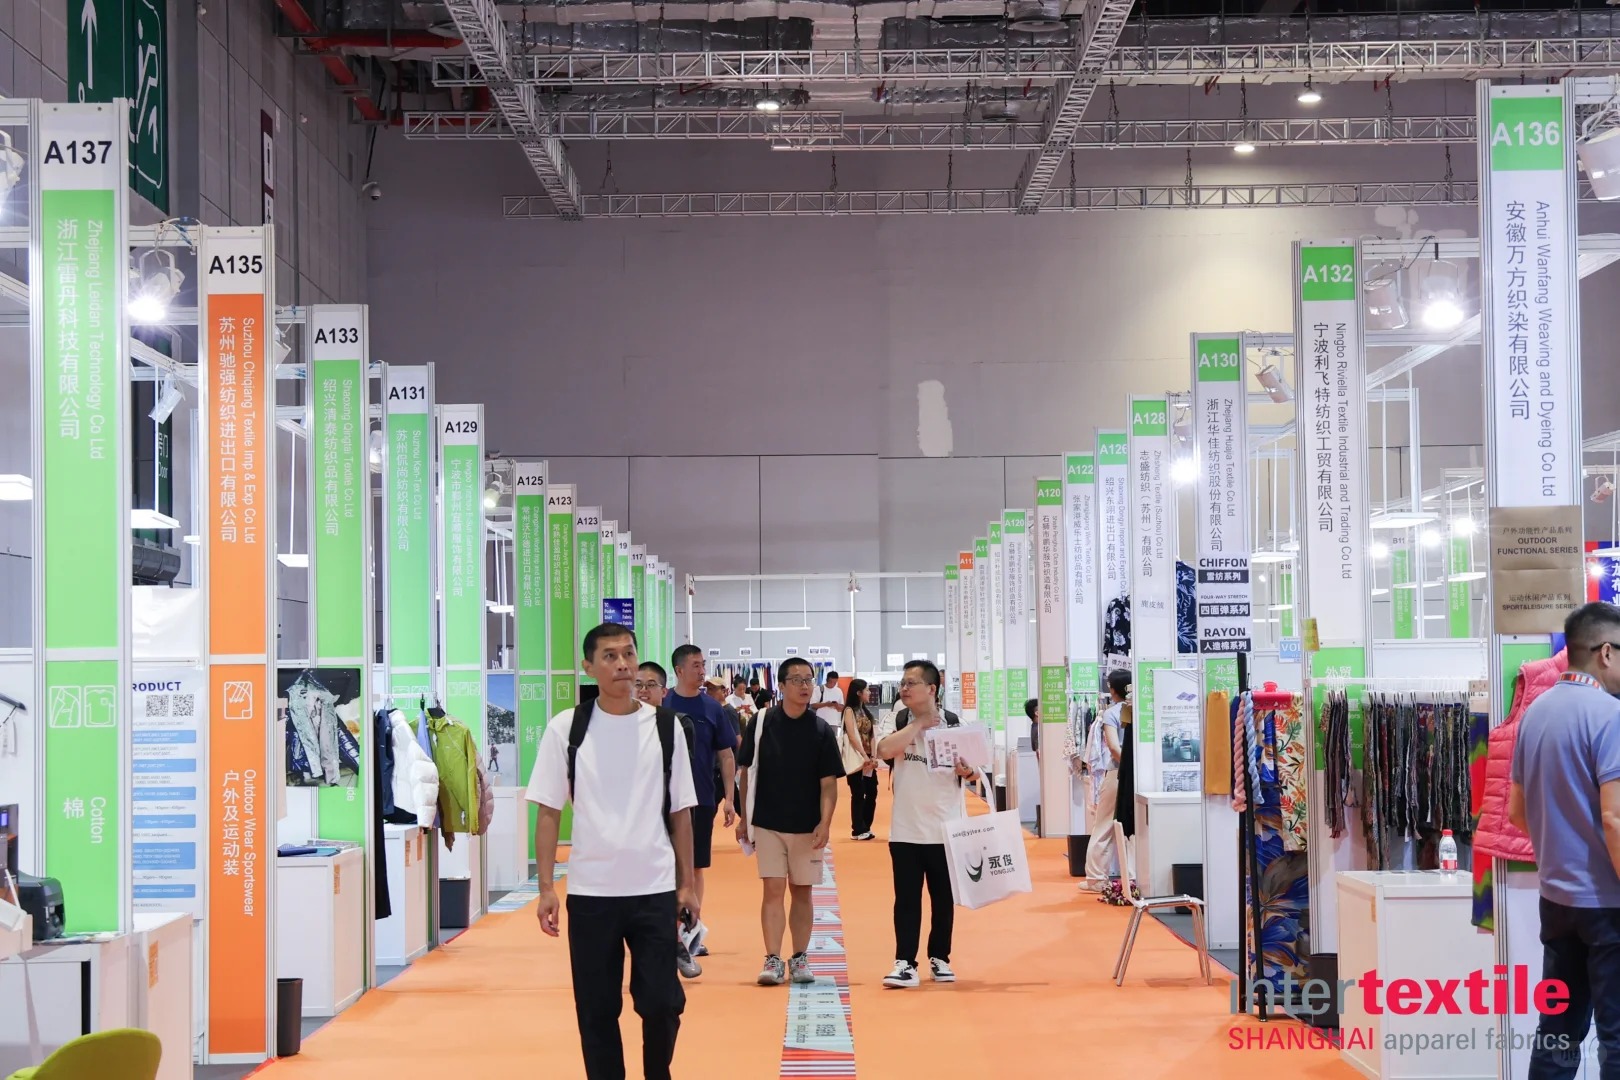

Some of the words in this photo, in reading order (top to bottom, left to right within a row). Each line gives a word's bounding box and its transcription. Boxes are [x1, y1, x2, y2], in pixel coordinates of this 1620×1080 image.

[1491, 121, 1560, 146] A136
[44, 140, 113, 164] A137
[1537, 200, 1550, 239] Anhui
[85, 219, 103, 278] Zhejiang
[209, 255, 263, 275] A135
[1303, 264, 1354, 283] A132
[1534, 244, 1552, 304] Wanfang
[88, 282, 103, 328] Leidan
[1505, 200, 1530, 420] 安徽万方织染有限公司
[56, 218, 80, 441] 浙江雷丹科技有限公司
[243, 317, 254, 358] Suzhou
[314, 328, 359, 344] A133
[1536, 308, 1553, 367] Weaving
[1334, 322, 1346, 358] Ningbo
[1198, 353, 1238, 368] A130
[86, 332, 104, 410] Technology
[1337, 361, 1348, 396] Riviella
[242, 360, 255, 408] Chiqiang
[388, 386, 426, 400] A131
[1540, 372, 1553, 396] and
[341, 379, 352, 420] Shaoxing
[90, 414, 104, 434] Co
[1133, 412, 1166, 425] A128
[1223, 398, 1233, 432] Zhejiang
[1338, 400, 1348, 432] Textile
[1538, 401, 1554, 448] Dyeing
[218, 316, 237, 543] 苏州驰强纺织进出口有限公司
[244, 411, 256, 446] Textile
[445, 421, 478, 433] A129
[1313, 322, 1333, 533] 宁波利飞特纺织工贸有限公司
[342, 422, 353, 454] Qingtai
[412, 430, 421, 458] Suzhou
[1224, 434, 1234, 460] Huajia
[90, 438, 105, 459] Ltd
[323, 379, 339, 536] 绍兴清泰纺织品有限公司
[1099, 444, 1127, 454] A126
[1338, 436, 1350, 480] Industrial
[242, 450, 256, 470] Imp
[1068, 464, 1094, 474] A122
[1541, 452, 1555, 472] Co
[244, 473, 256, 481] &
[344, 456, 354, 486] Textile
[413, 460, 422, 493] Kan-Tex
[517, 475, 543, 486] A125
[1206, 398, 1223, 552] 浙江华佳纺织股份有限公司
[1226, 462, 1234, 488] Textile
[242, 484, 256, 504] Exp
[344, 488, 354, 502] Co
[1037, 488, 1061, 498] A120
[1154, 482, 1162, 504] Textile
[1226, 490, 1235, 502] Co
[1340, 484, 1350, 502] and
[1542, 476, 1556, 496] Ltd
[414, 494, 422, 506] Co
[548, 496, 572, 506] A123
[1226, 504, 1236, 516] Ltd
[244, 508, 256, 524] Co
[344, 504, 354, 518] Ltd
[414, 508, 422, 520] Ltd
[577, 517, 598, 525] A123
[1154, 506, 1163, 536] (Suzhou)
[1005, 518, 1024, 527] A120
[1338, 505, 1351, 543] Trading
[244, 526, 256, 544] Ltd
[1156, 537, 1163, 546] Co
[1156, 548, 1164, 558] Ltd
[1341, 546, 1352, 560] Co
[1497, 547, 1548, 555] FUNCTIONAL
[1200, 558, 1247, 567] CHIFFON
[1342, 563, 1352, 579] Ltd
[1120, 580, 1126, 589] Co
[1206, 571, 1241, 581] 雪纺系列
[1200, 605, 1249, 615] 四面弹系列
[1204, 627, 1246, 637] RAYON
[1204, 641, 1247, 651] 人造棉系列
[1325, 666, 1351, 679] 外贸
[525, 725, 534, 743] 化纤
[243, 769, 256, 815] Outdoor
[63, 796, 84, 820] 棉
[90, 796, 106, 844] Cotton
[222, 770, 239, 876] 户外及运动装
[243, 818, 256, 848] Wear
[988, 854, 1013, 869] 永俊
[242, 852, 256, 916] Sportswear
